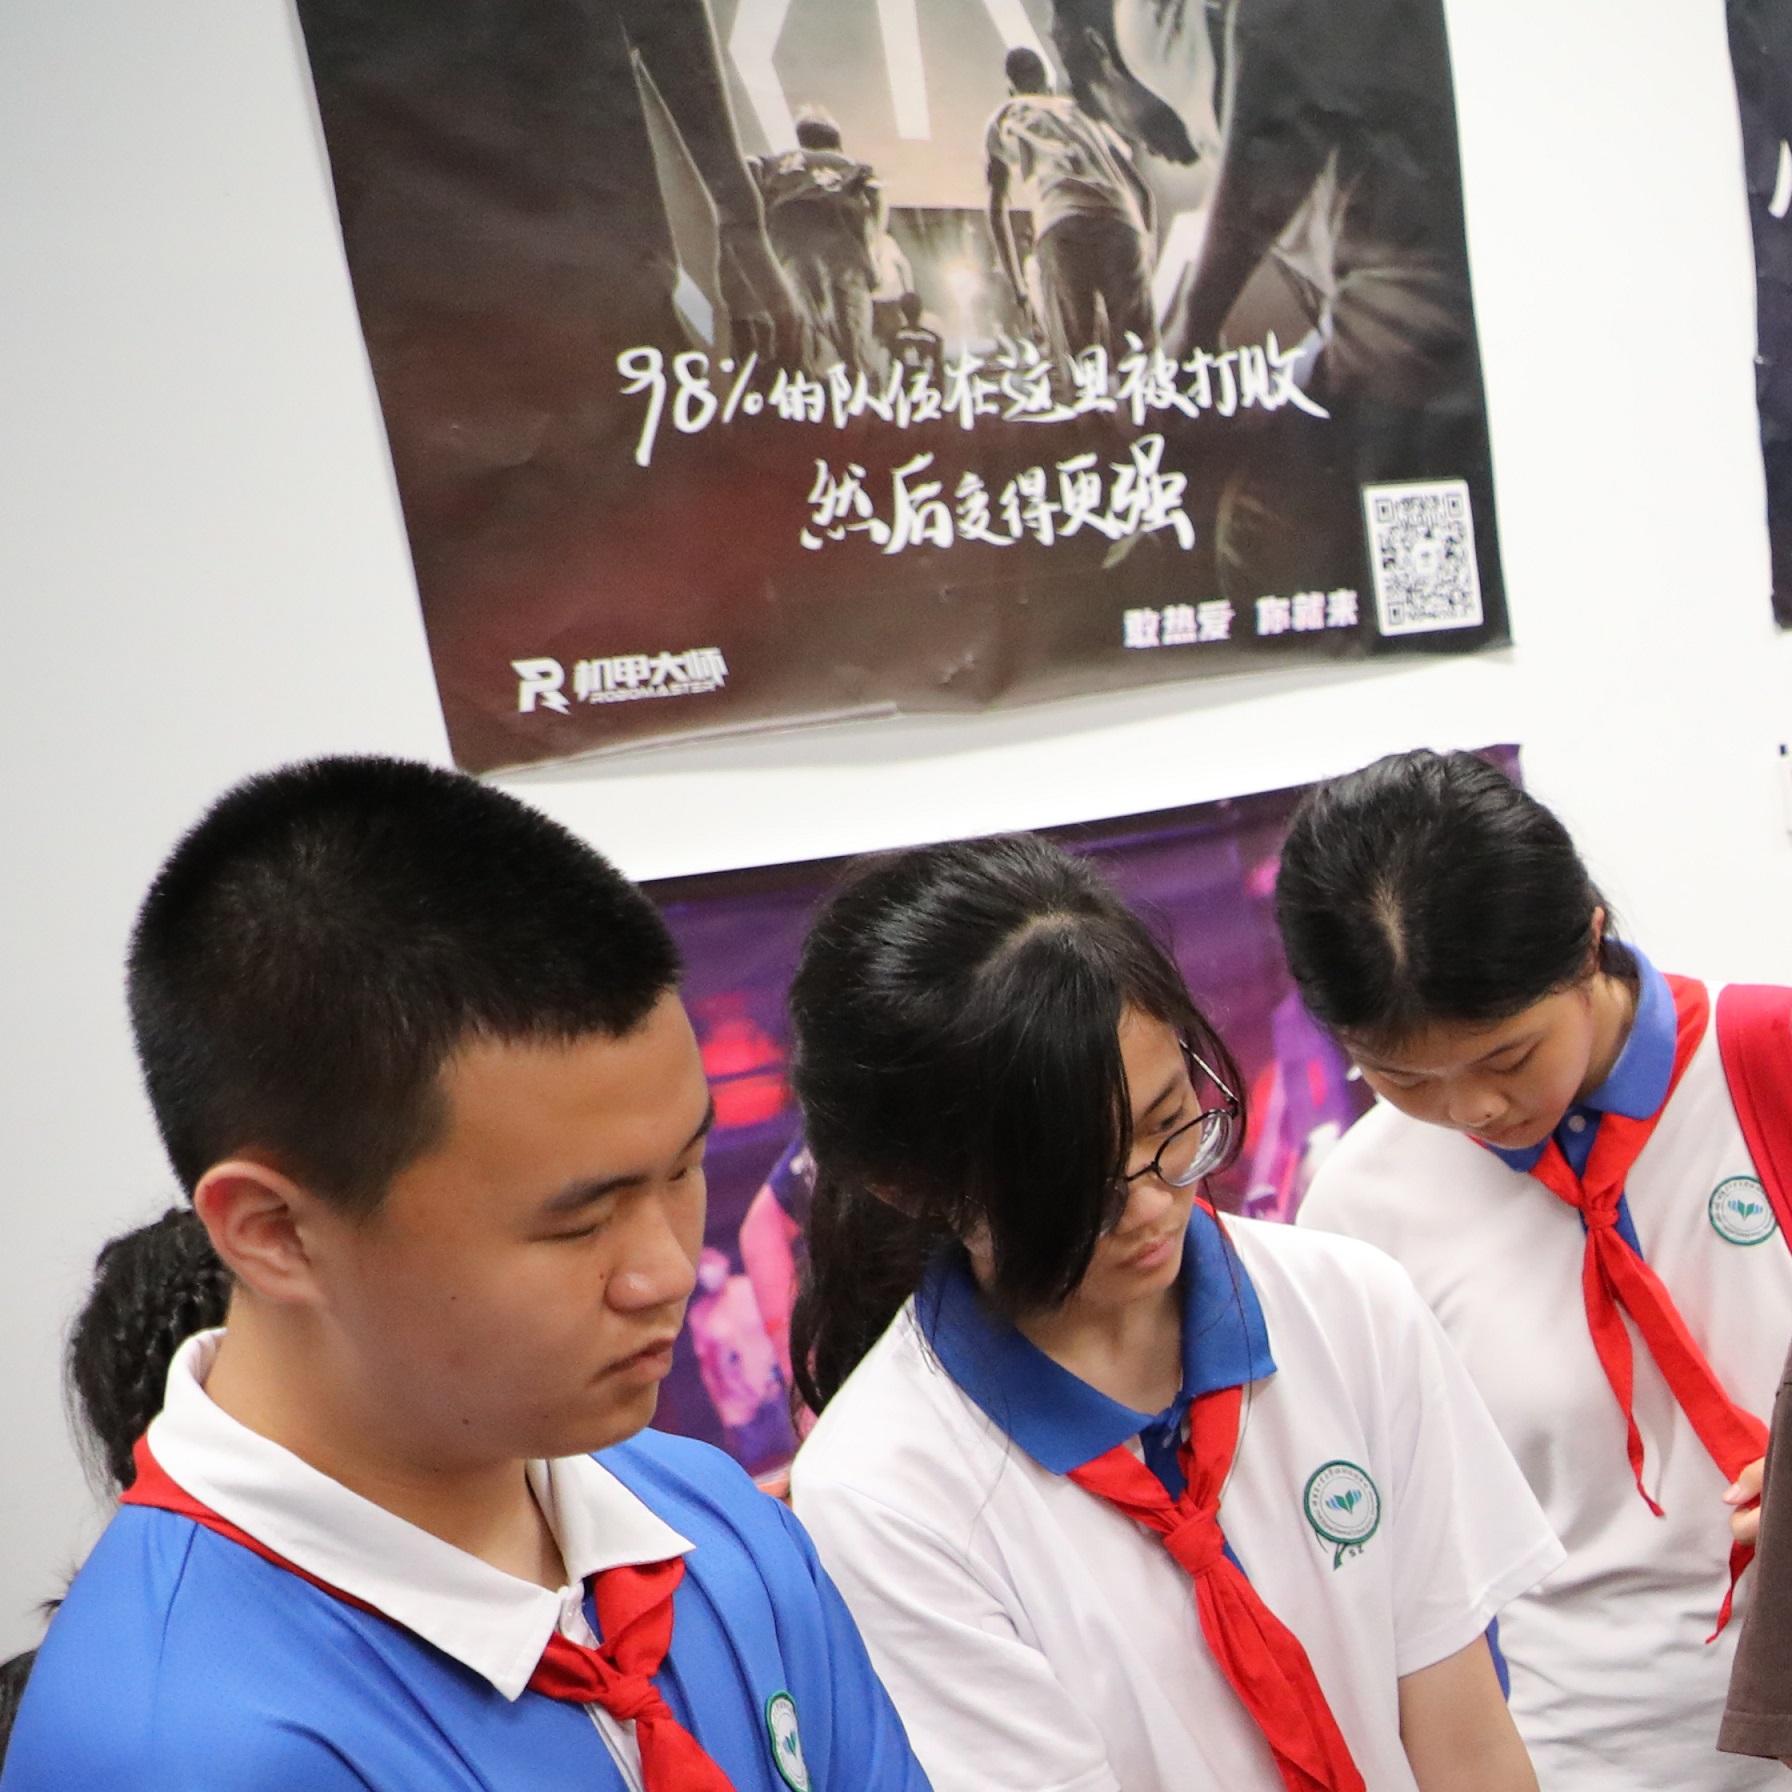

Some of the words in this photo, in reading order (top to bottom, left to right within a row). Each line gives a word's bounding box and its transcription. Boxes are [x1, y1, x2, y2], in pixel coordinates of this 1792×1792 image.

[799, 433, 1196, 555] 然后变得更强
[573, 647, 729, 701] 机甲大师
